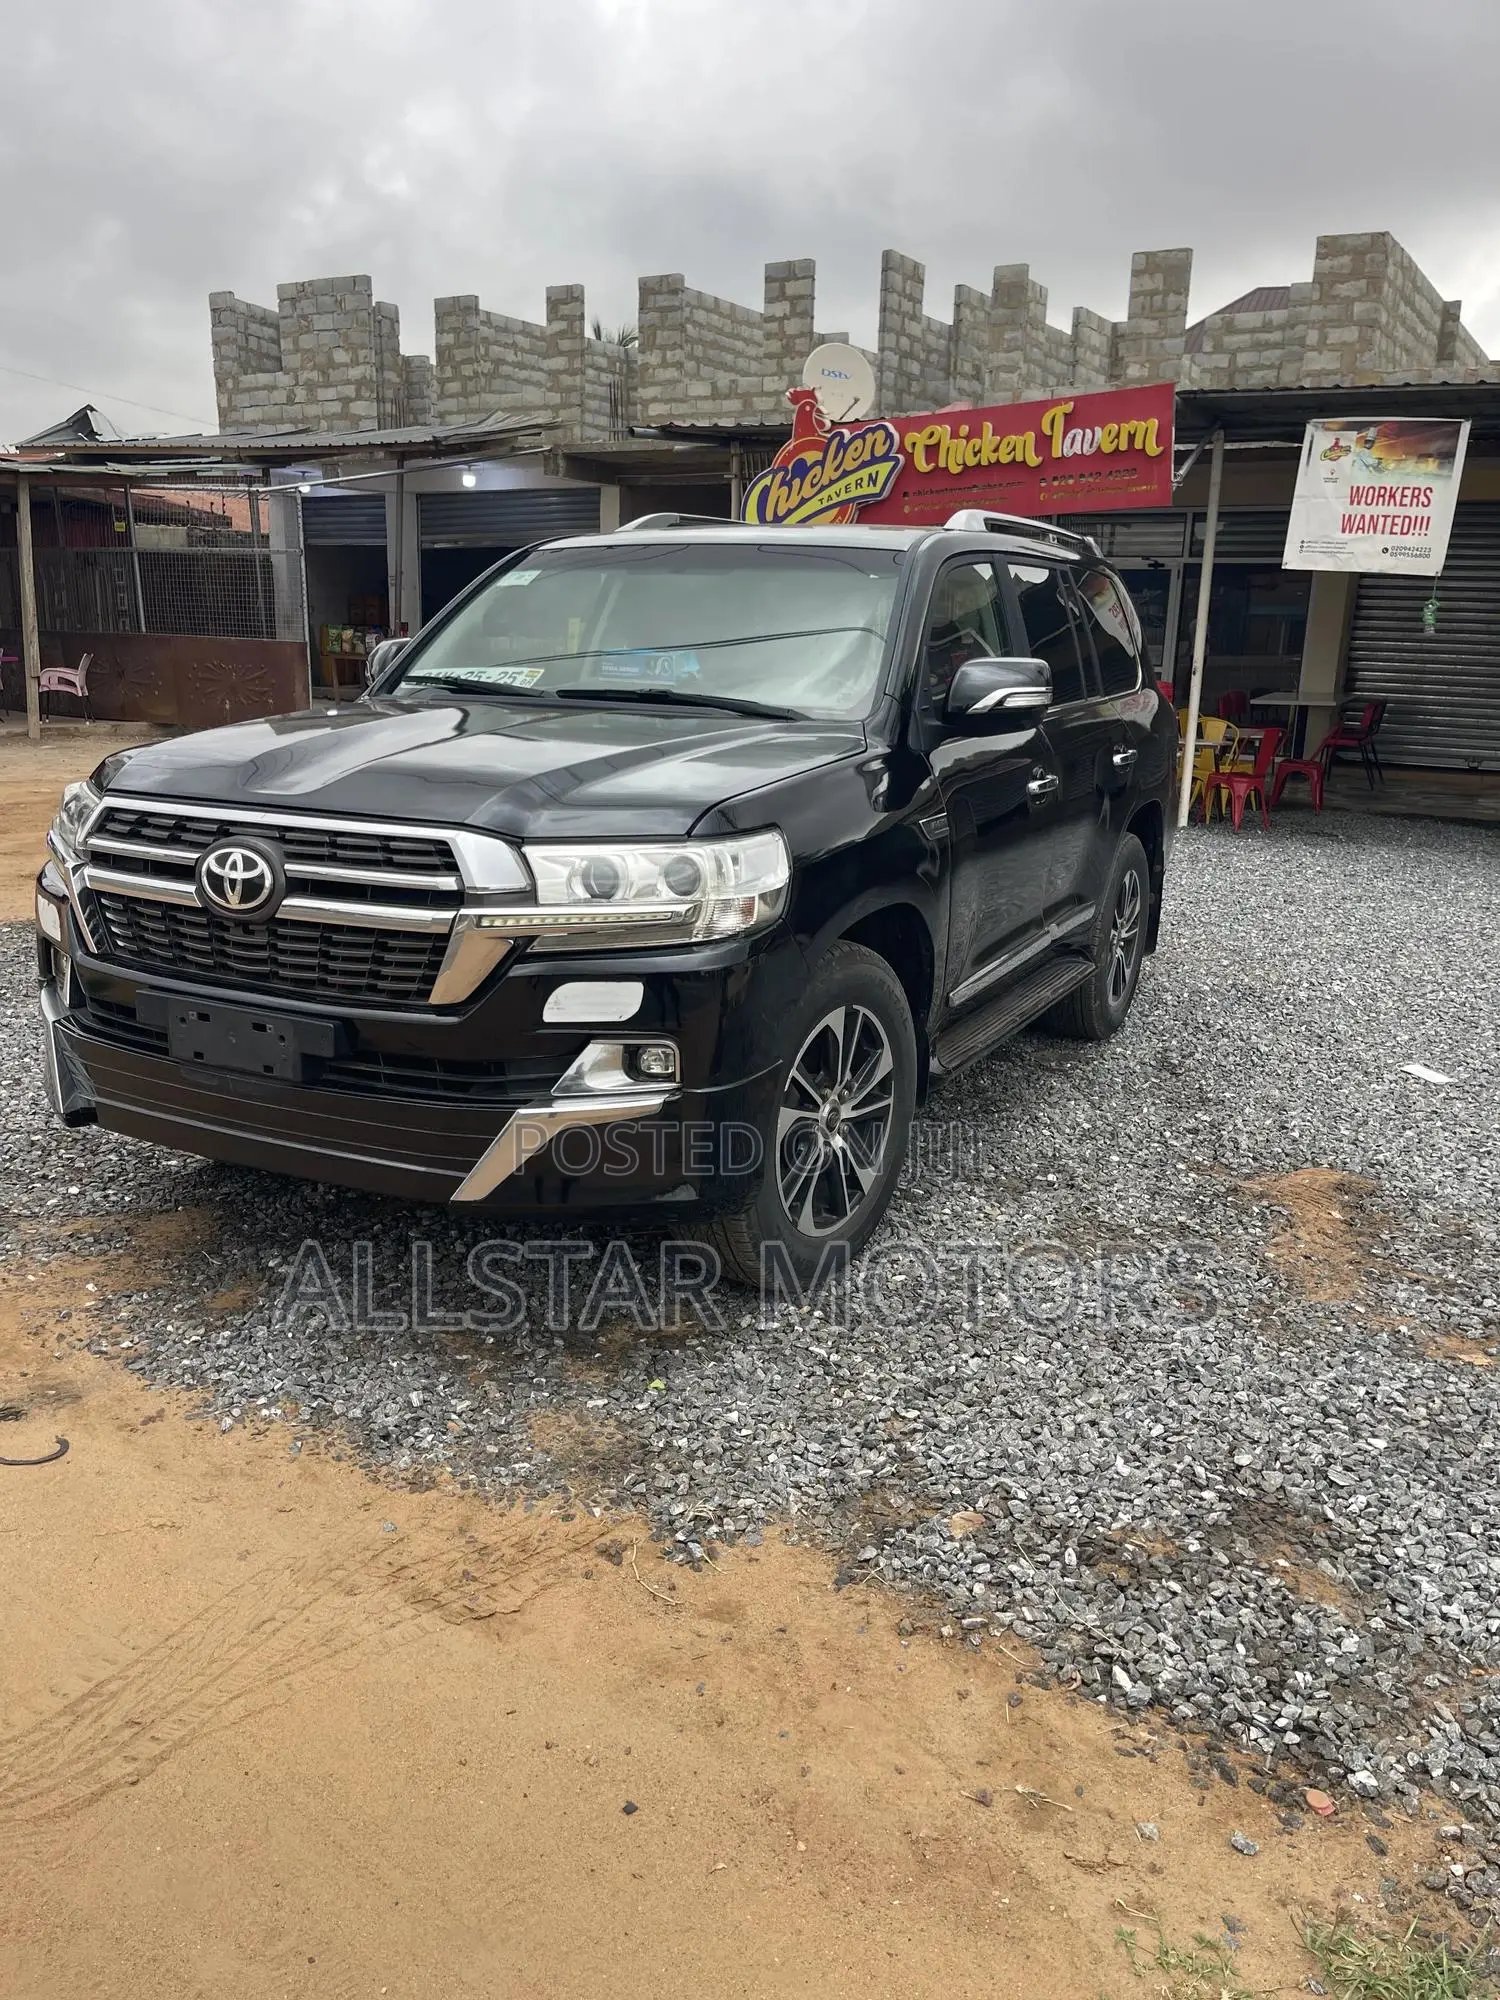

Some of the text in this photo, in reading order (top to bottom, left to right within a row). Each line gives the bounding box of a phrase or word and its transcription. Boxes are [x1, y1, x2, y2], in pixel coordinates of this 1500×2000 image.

[904, 401, 1165, 475] Chicken Tavern
[745, 429, 890, 524] Chicken
[817, 470, 880, 506] TAVERN
[1349, 485, 1434, 508] WORKERS
[1340, 513, 1431, 537] WANTED!!!
